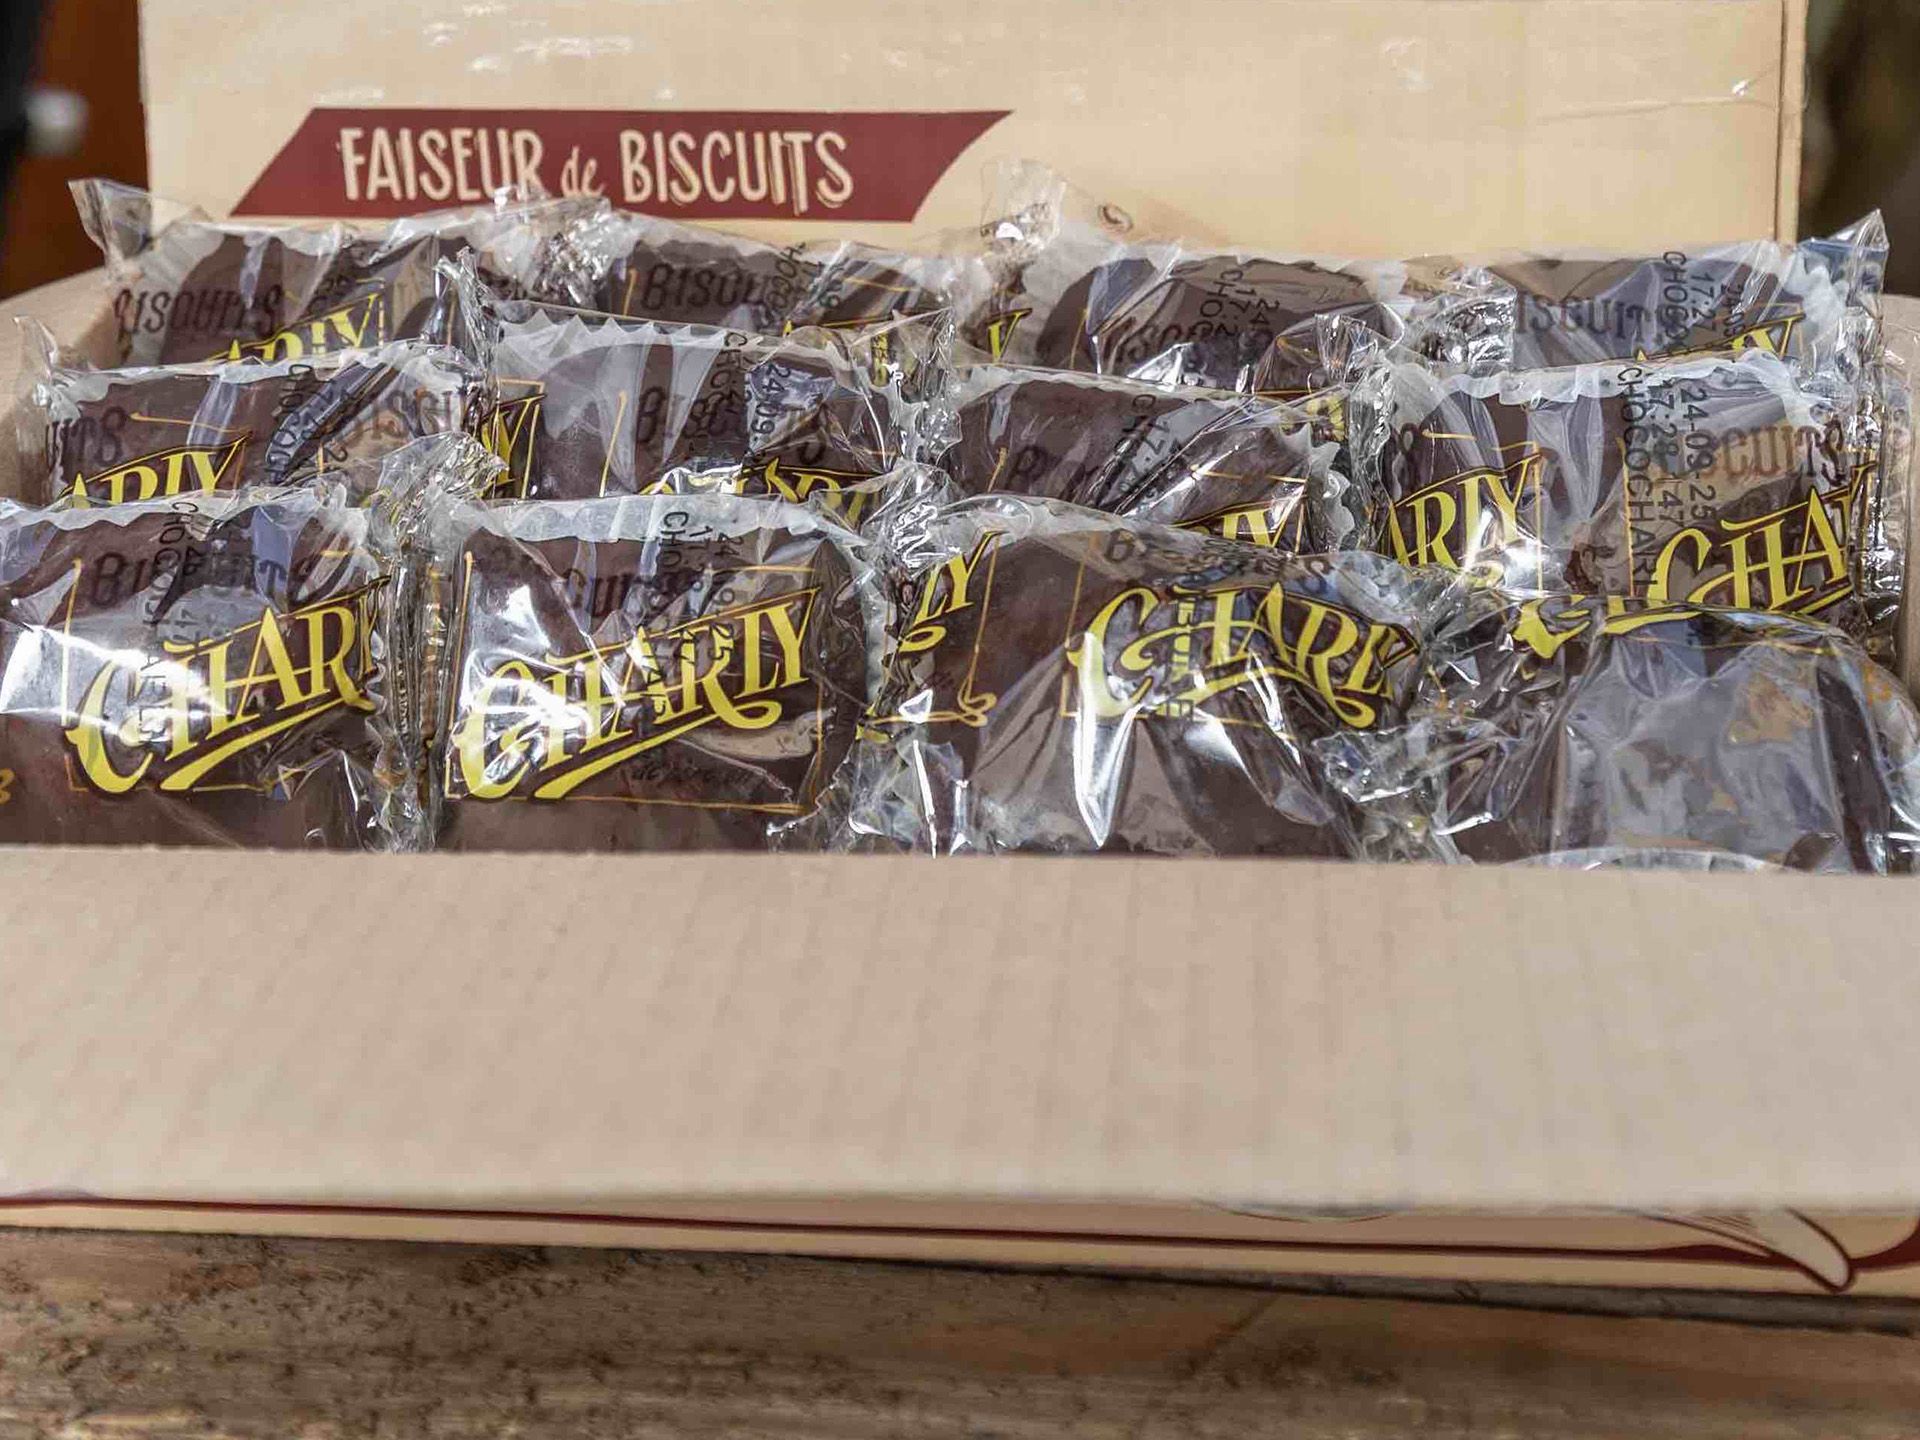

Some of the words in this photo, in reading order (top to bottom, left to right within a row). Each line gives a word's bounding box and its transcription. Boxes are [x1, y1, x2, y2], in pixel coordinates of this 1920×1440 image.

[337, 127, 545, 201] FAISEUR
[560, 146, 605, 199] de
[619, 130, 855, 215] BISCUITS
[452, 589, 820, 799] CHARLY
